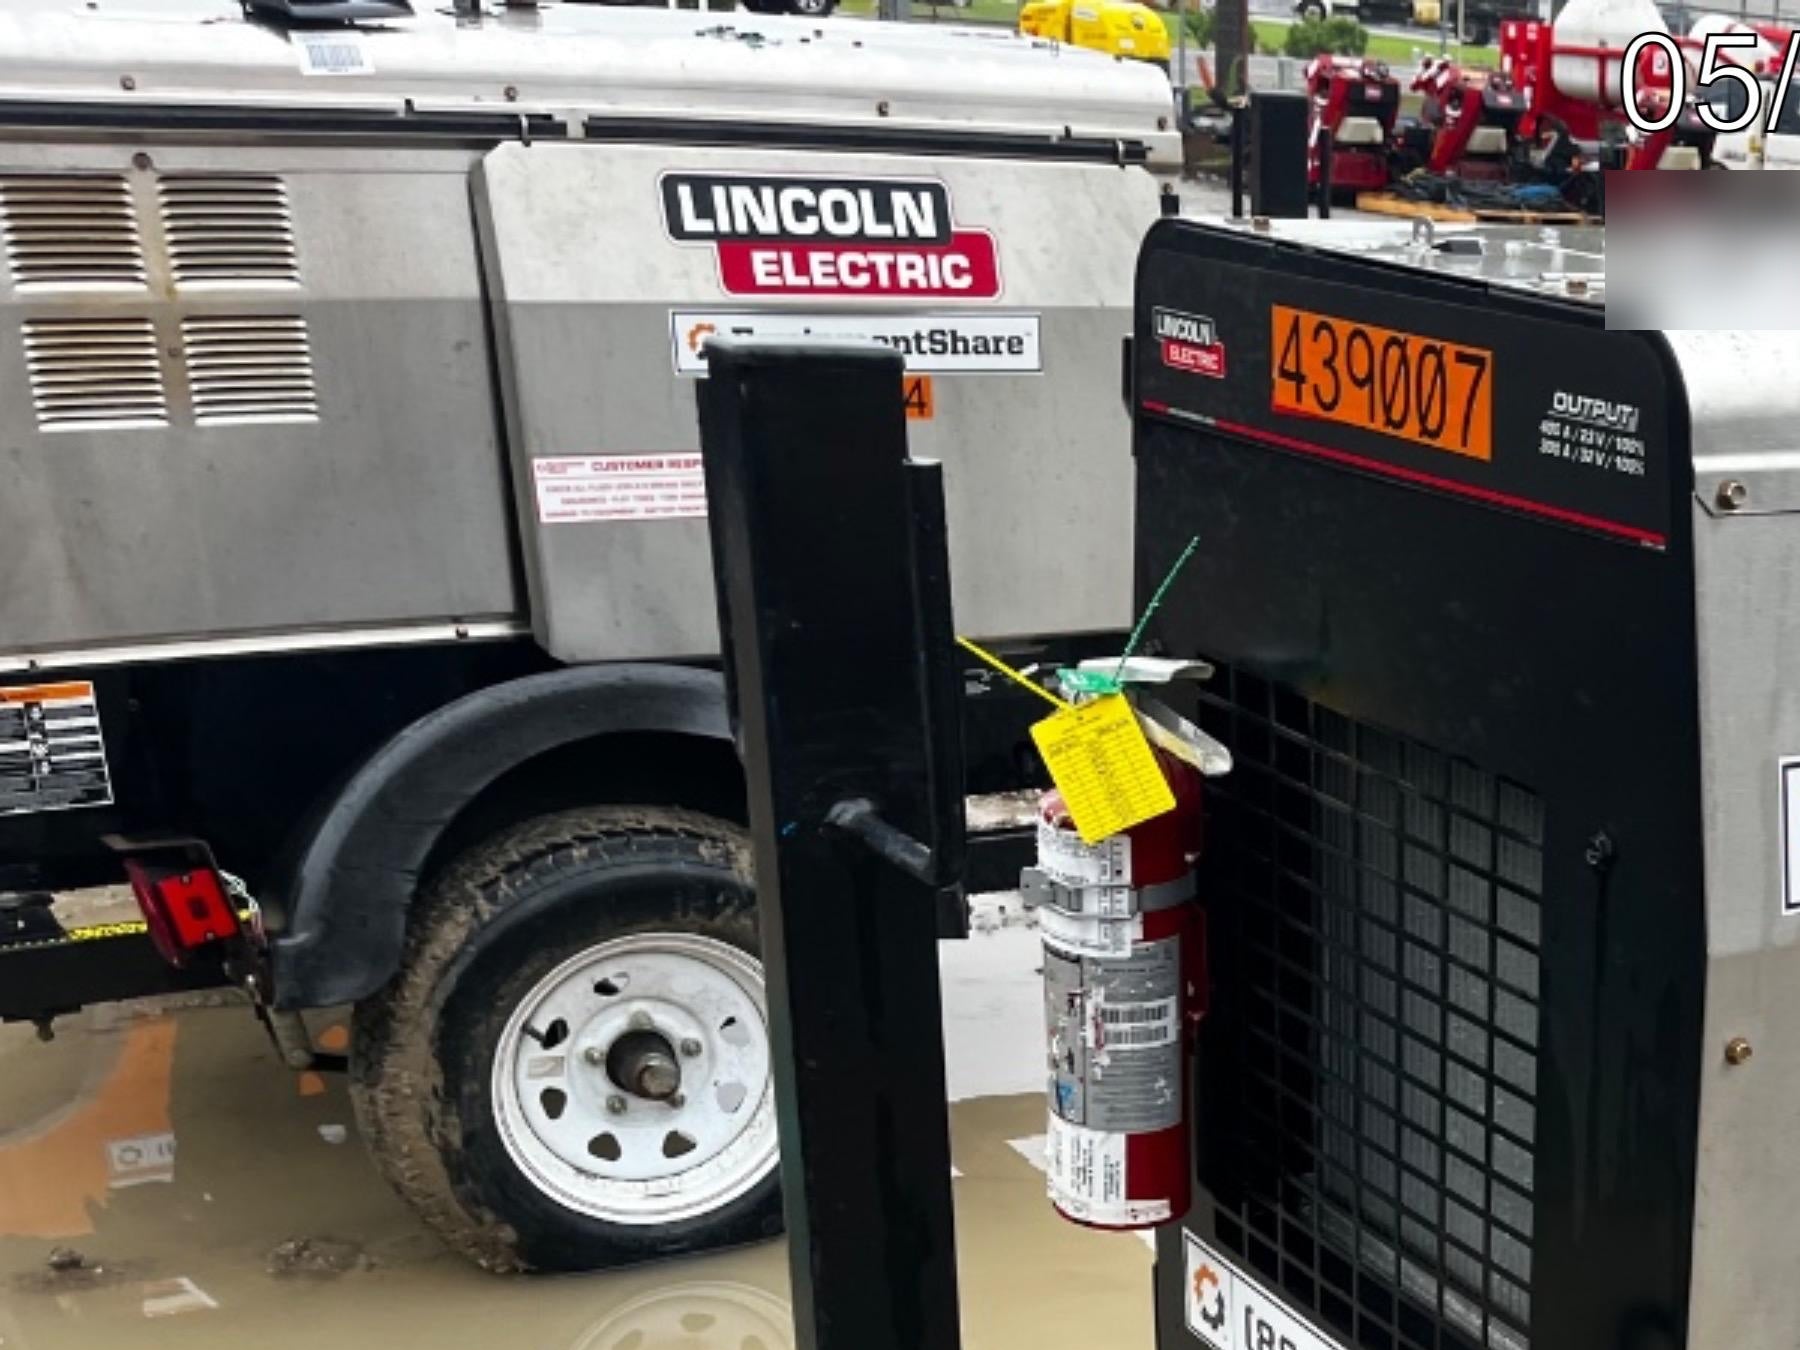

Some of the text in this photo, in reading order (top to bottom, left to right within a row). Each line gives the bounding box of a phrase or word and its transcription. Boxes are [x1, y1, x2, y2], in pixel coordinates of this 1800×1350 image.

[677, 183, 938, 238] LINCOLN
[750, 250, 974, 289] ELECTRIC
[1156, 314, 1210, 346] LINCOLN
[1168, 343, 1219, 370] ELECTRIC
[1277, 314, 1487, 448] 439007
[1552, 391, 1634, 425] OUTPUT
